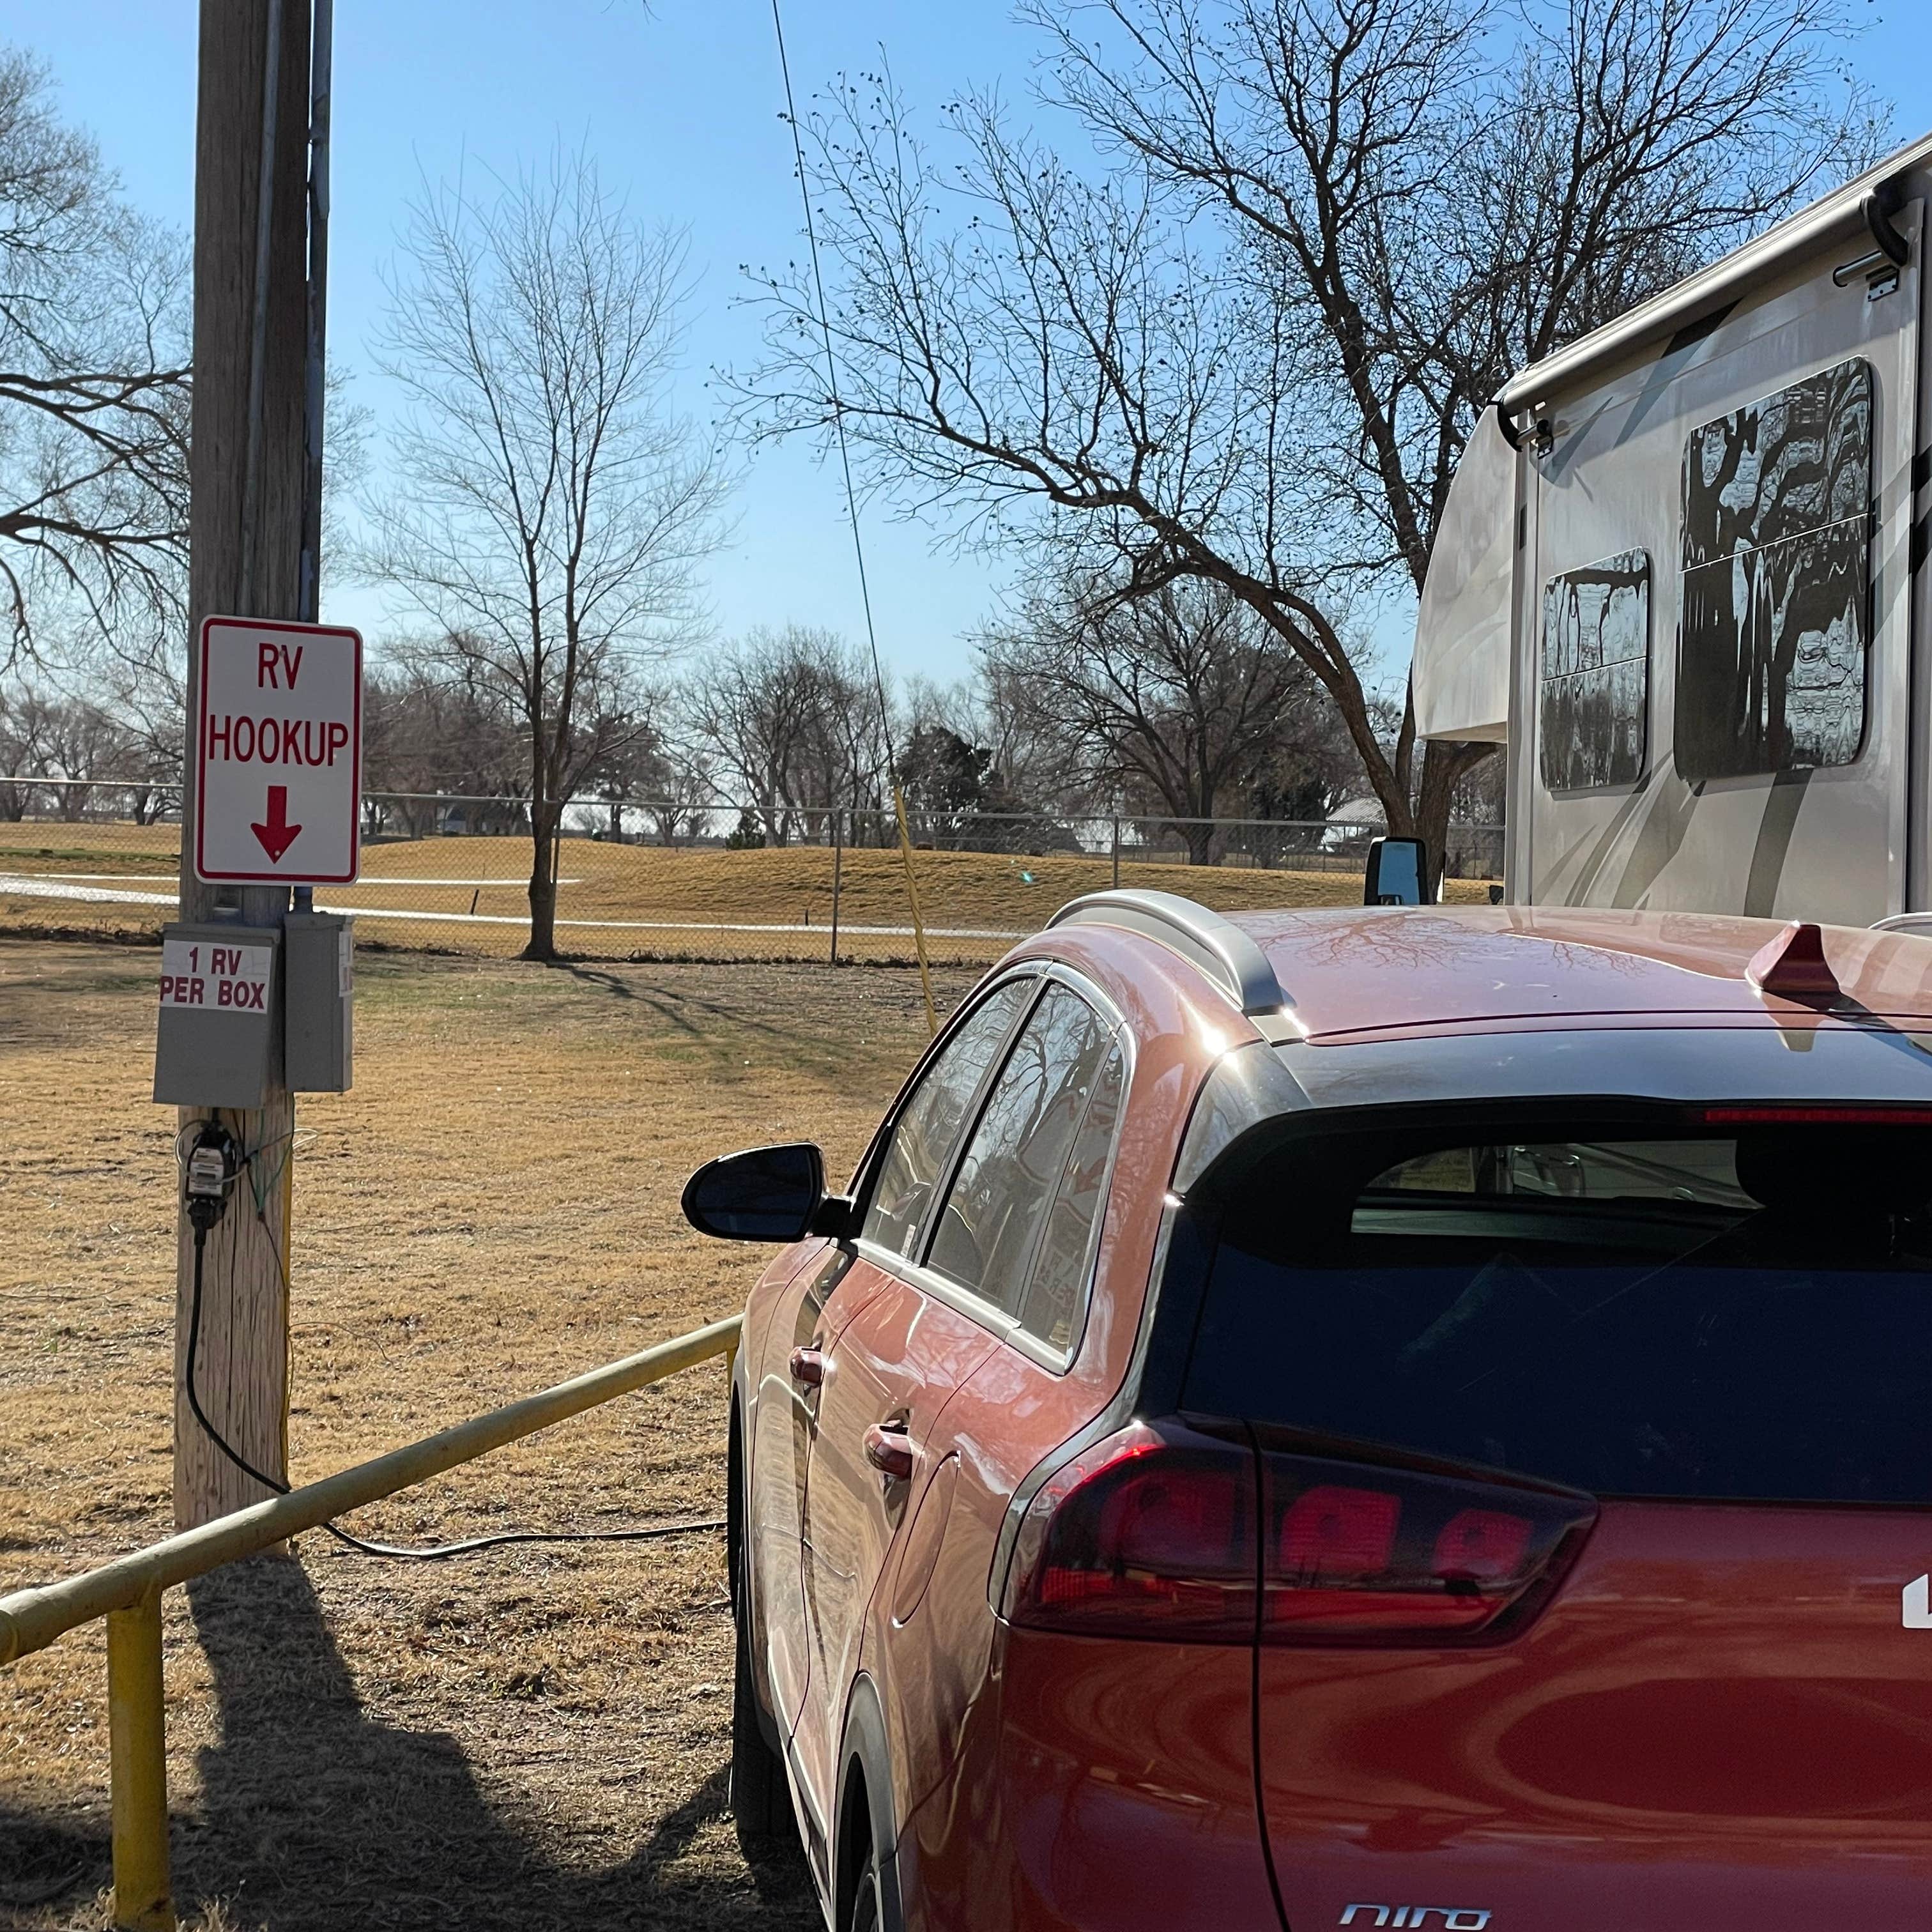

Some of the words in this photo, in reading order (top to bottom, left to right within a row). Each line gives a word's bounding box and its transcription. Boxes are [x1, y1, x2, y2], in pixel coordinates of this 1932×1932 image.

[257, 642, 303, 690] RV
[208, 714, 349, 767] HOOKUP
[189, 946, 199, 974] 1
[210, 948, 243, 976] RV
[160, 975, 205, 1005] PER
[217, 979, 266, 1010] BOX
